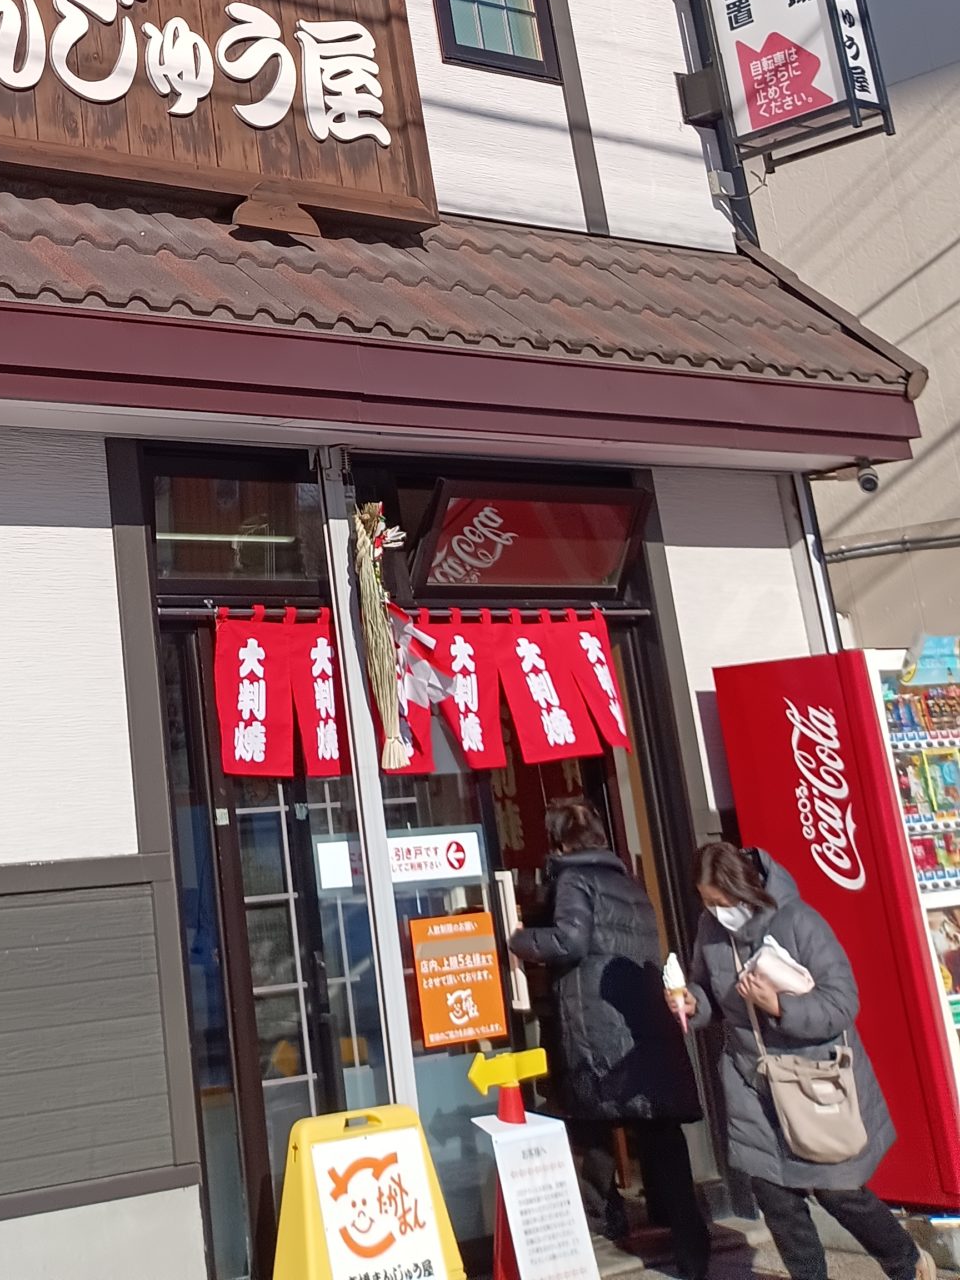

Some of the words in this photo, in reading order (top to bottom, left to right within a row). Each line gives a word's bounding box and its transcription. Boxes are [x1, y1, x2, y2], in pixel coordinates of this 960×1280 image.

[749, 46, 798, 77] 自転車は
[753, 61, 801, 89] こちらに
[756, 81, 791, 106] 止めて
[759, 92, 813, 117] ください。
[234, 637, 267, 763] 大判焼
[310, 636, 340, 761] 大判焼
[450, 634, 486, 752] 大判焼
[515, 637, 577, 747] 大判焼
[783, 696, 866, 890] Coca-Cola
